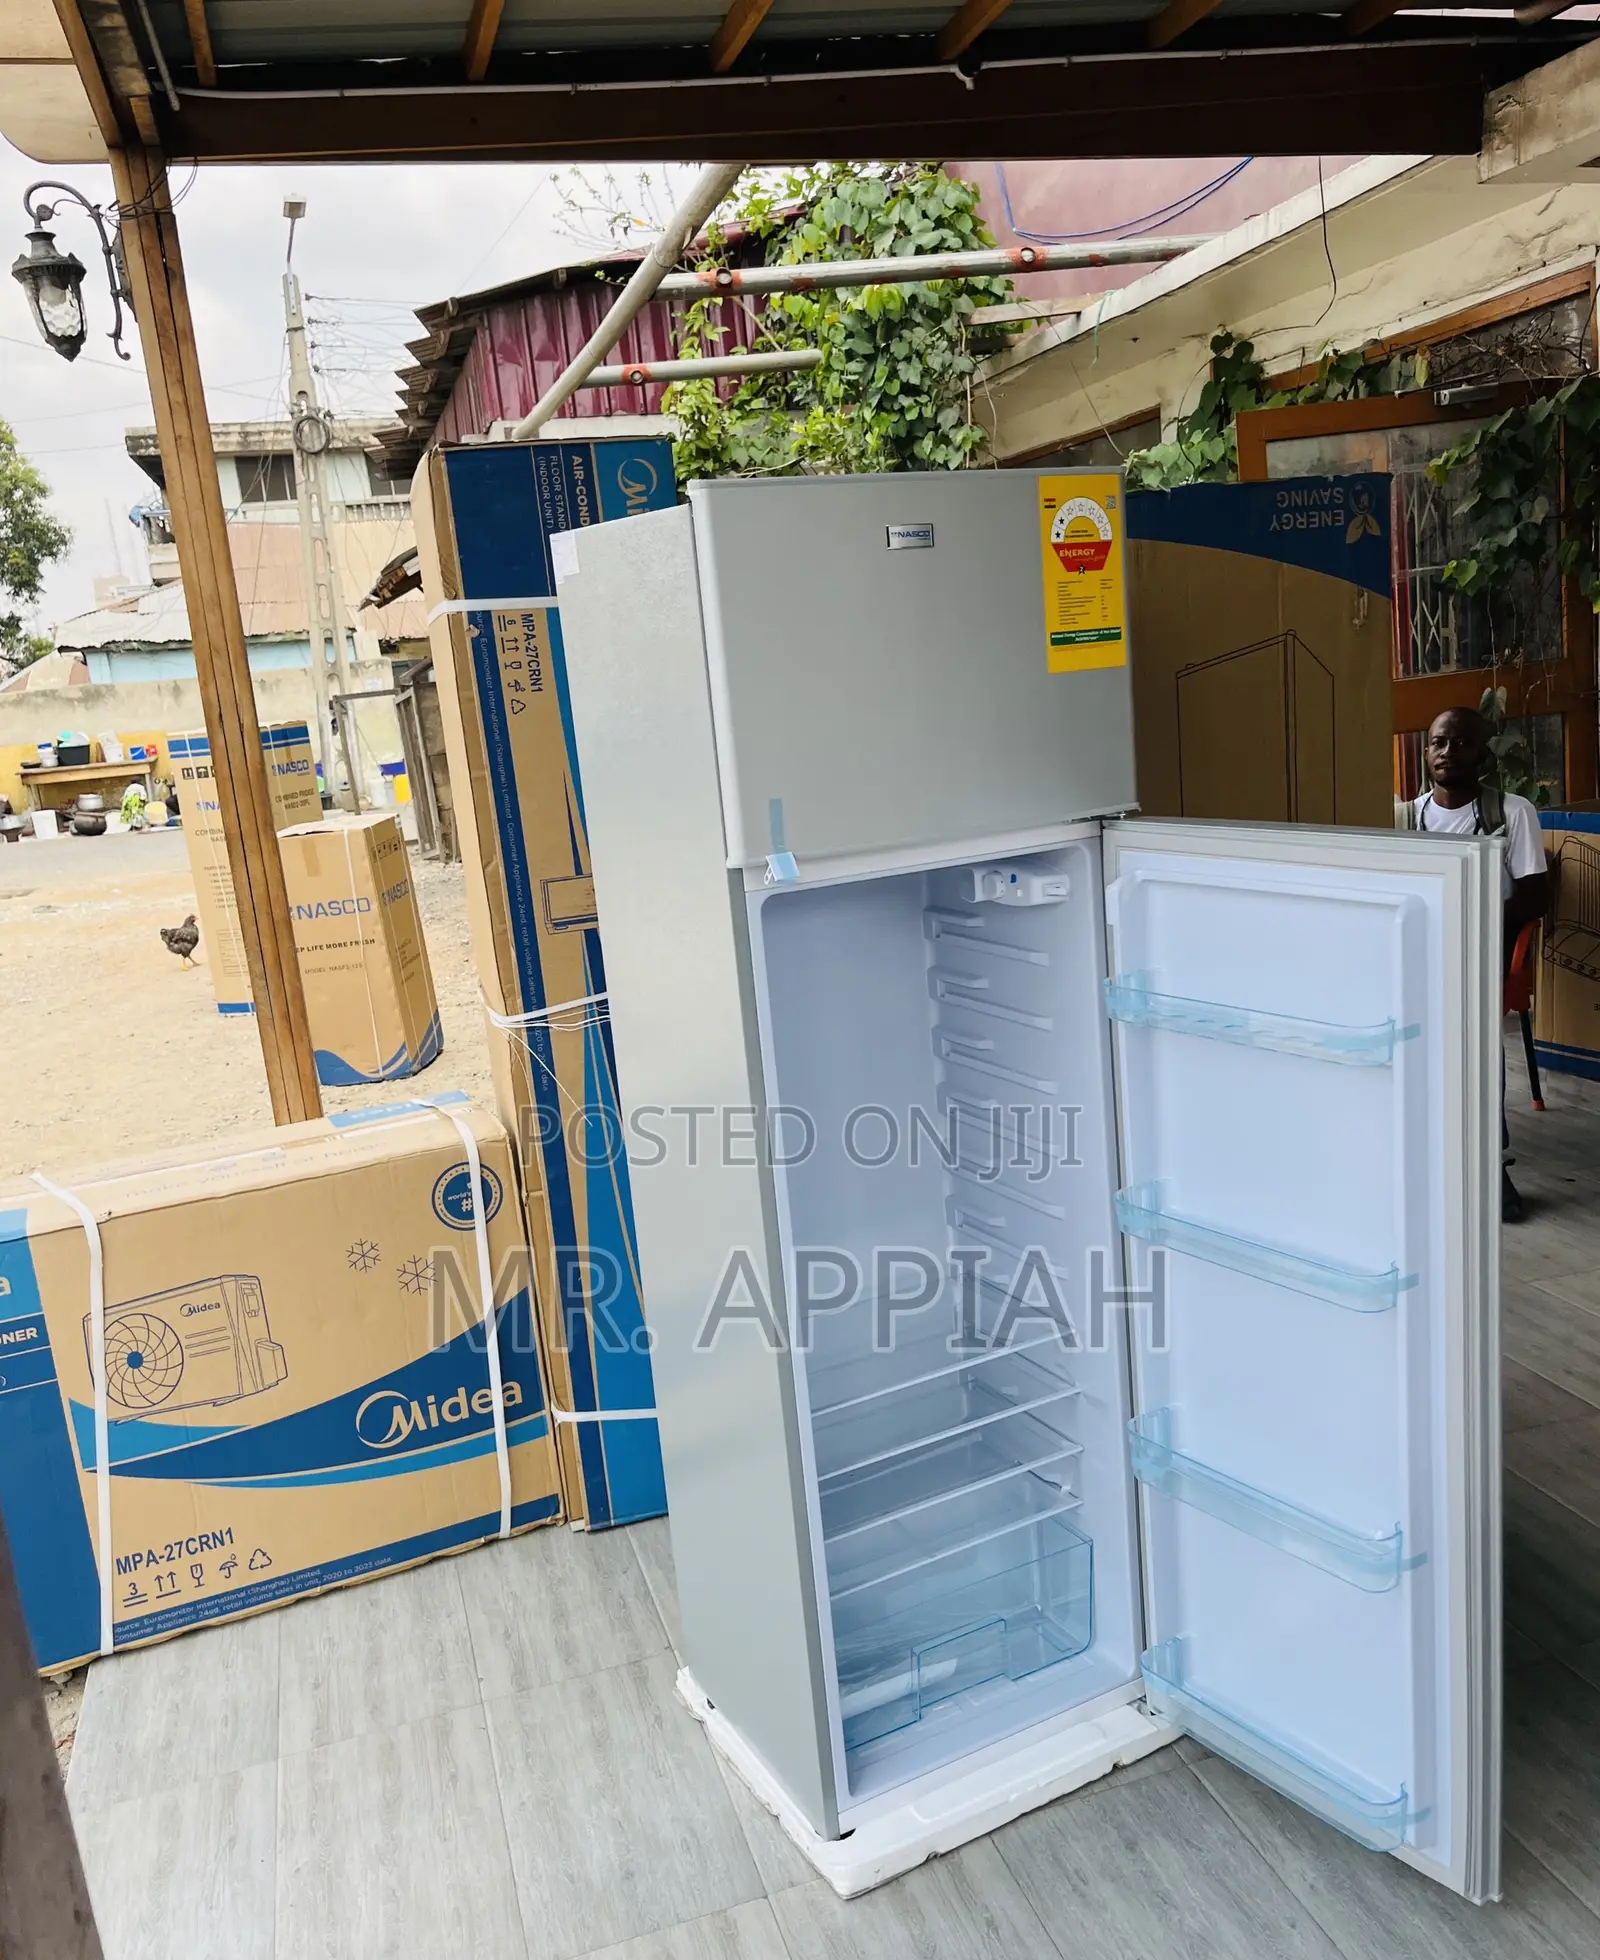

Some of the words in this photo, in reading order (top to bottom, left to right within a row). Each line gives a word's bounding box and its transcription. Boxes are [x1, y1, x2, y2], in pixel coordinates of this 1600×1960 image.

[538, 456, 551, 499] (INDOOR
[550, 455, 561, 492] FLOOR
[1277, 487, 1344, 508] SAVING
[544, 501, 555, 529] UNIT)
[554, 494, 567, 532] STAND
[1269, 509, 1345, 532] ENERGY
[1060, 548, 1096, 558] ENERGY
[479, 637, 493, 689] Euromonitor
[520, 613, 543, 693] MPA-27CRN1
[487, 690, 501, 742] International
[277, 759, 309, 776] NASCO
[507, 822, 519, 861] Consumer
[513, 863, 524, 902] Appliance
[296, 897, 371, 921] NASCO
[307, 944, 324, 952] LIFE
[325, 941, 348, 950] MORE
[522, 926, 531, 946] retail
[304, 966, 326, 975] MODEL
[524, 948, 533, 975] volume
[528, 976, 537, 995] sales
[537, 1043, 545, 1052] to
[180, 1302, 221, 1317] Midea
[0, 1327, 39, 1345] NER
[356, 1378, 523, 1449] Midea
[115, 1526, 235, 1576] MPA-27CRN1
[128, 1582, 139, 1596] 3
[144, 1606, 195, 1626] Euromonitor
[196, 1589, 246, 1611] International
[247, 1578, 291, 1598] (Shanghai)
[156, 1612, 197, 1631] Appliance
[222, 1600, 243, 1612] retail
[245, 1591, 273, 1605] volume
[275, 1585, 295, 1597] sales
[295, 1582, 303, 1590] in
[322, 1570, 343, 1583] 2020
[344, 1568, 353, 1577] to
[354, 1562, 373, 1573] 2023
